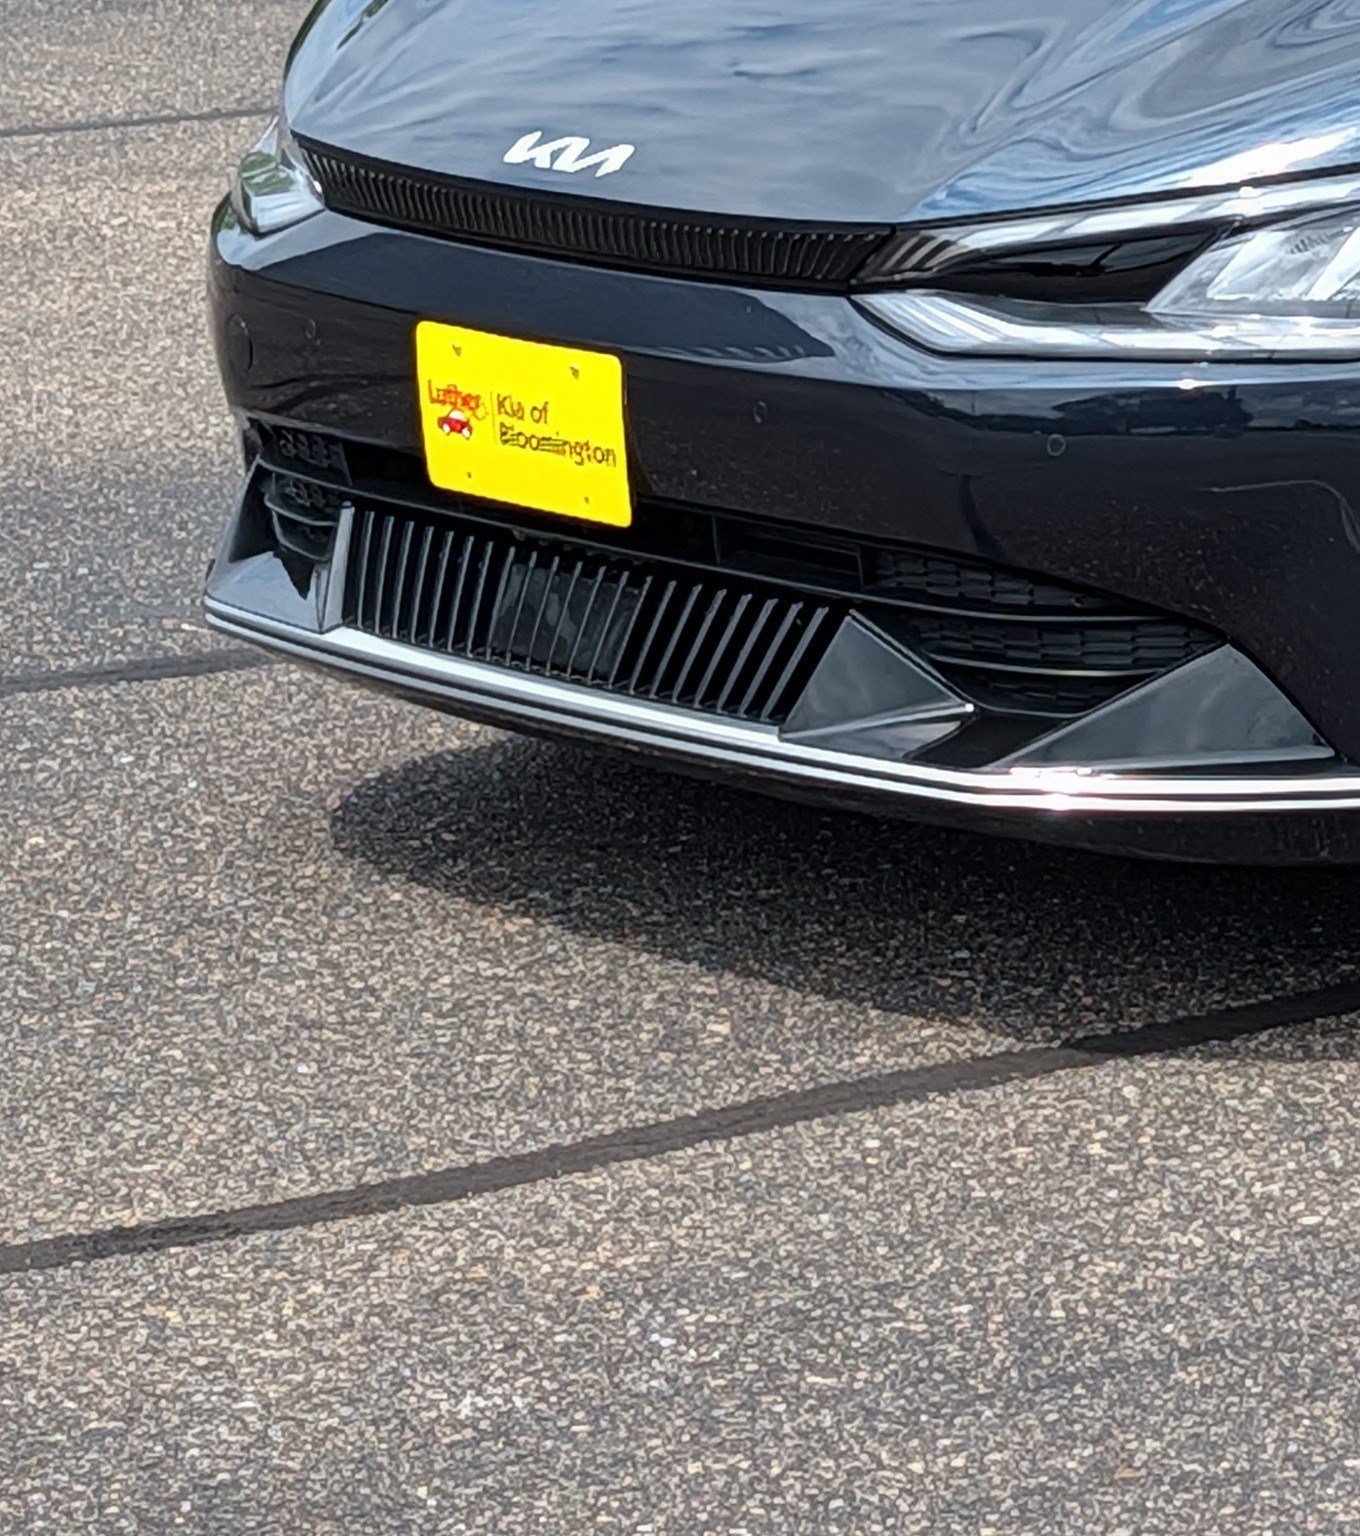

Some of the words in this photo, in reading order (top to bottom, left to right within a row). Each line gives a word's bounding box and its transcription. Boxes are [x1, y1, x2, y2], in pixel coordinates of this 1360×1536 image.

[427, 379, 482, 413] Luther
[497, 392, 525, 421] Kia
[530, 400, 549, 425] of
[499, 421, 617, 468] Bloomington
